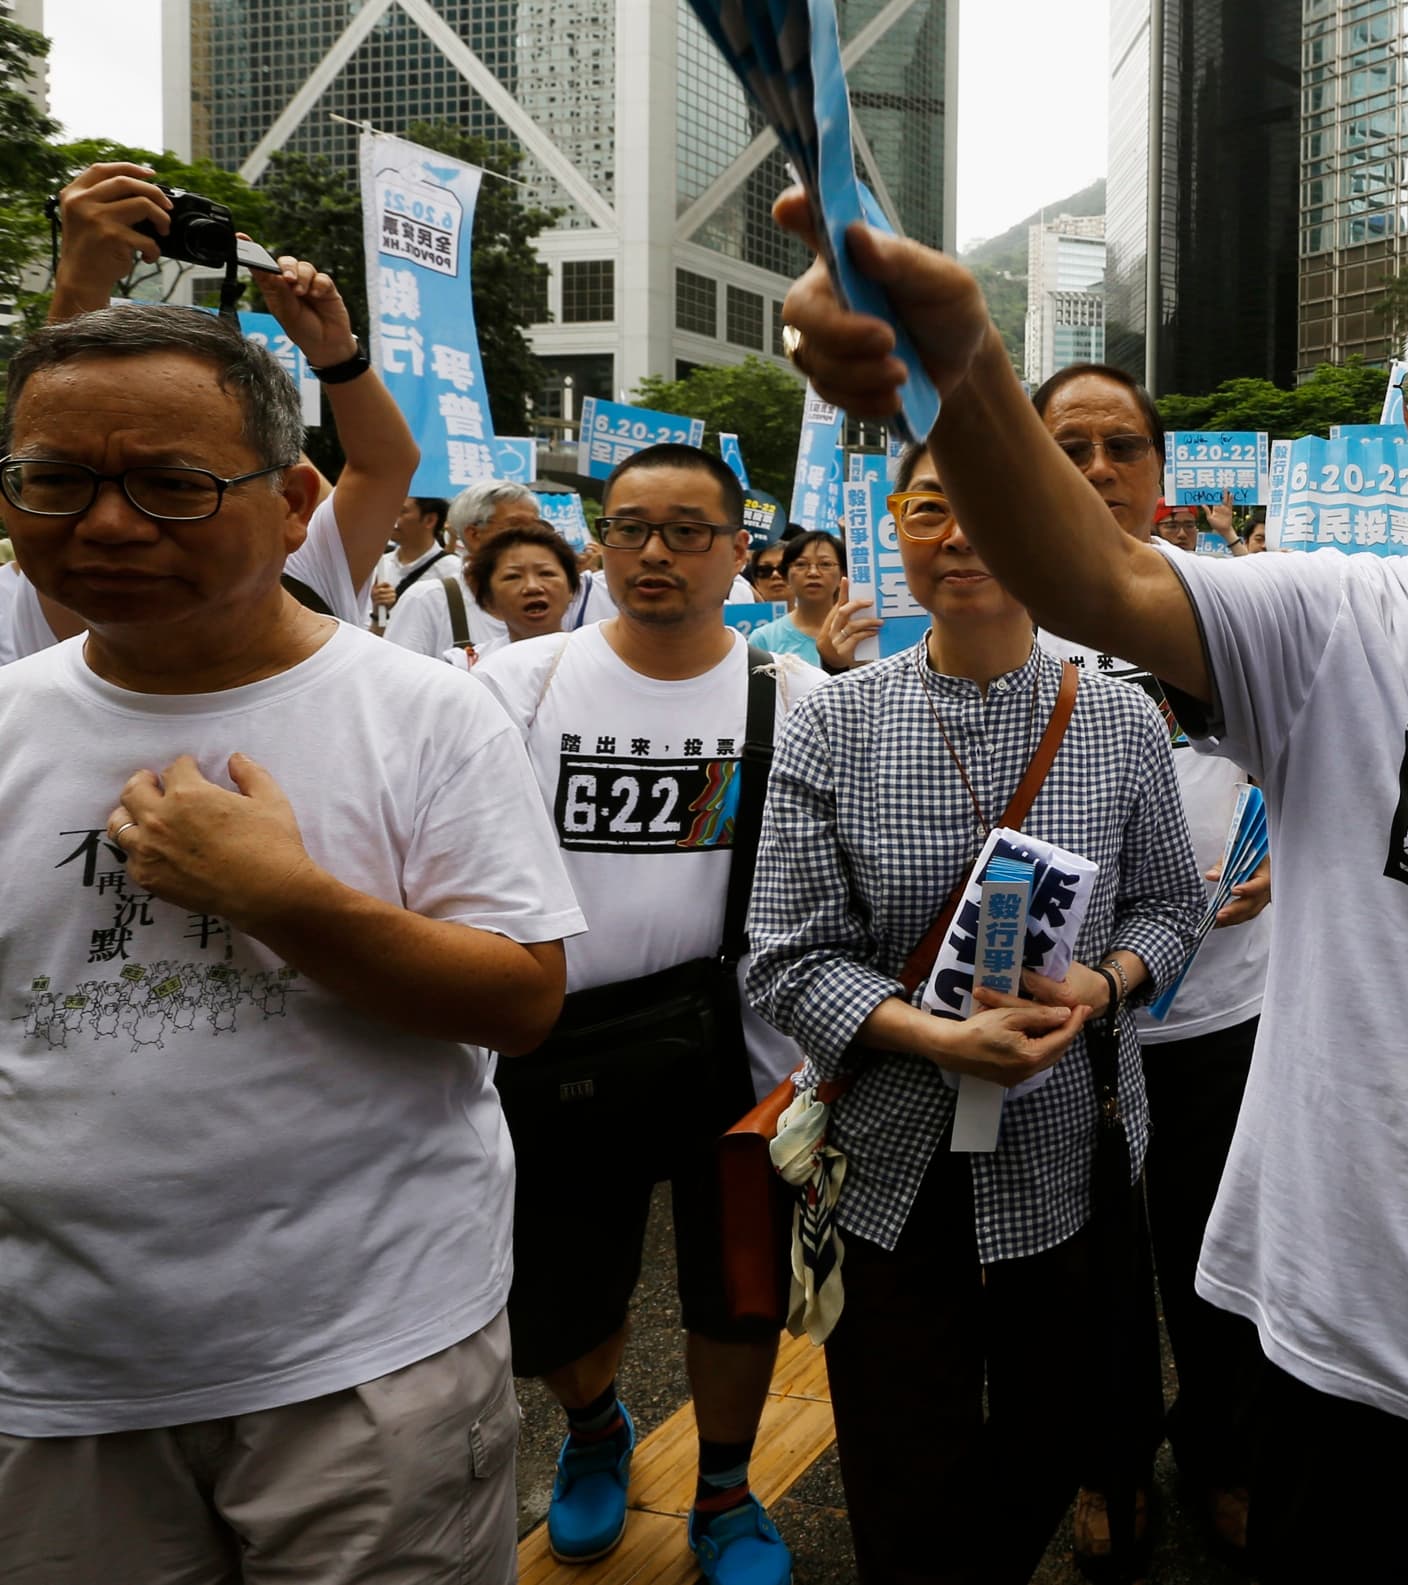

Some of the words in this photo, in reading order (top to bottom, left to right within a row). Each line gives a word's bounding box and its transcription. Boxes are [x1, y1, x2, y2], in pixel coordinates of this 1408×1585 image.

[594, 414, 688, 444] 6.20-22
[590, 440, 635, 465] 全民
[1176, 444, 1256, 461] 6.20-22
[1176, 469, 1256, 489] 全民投票
